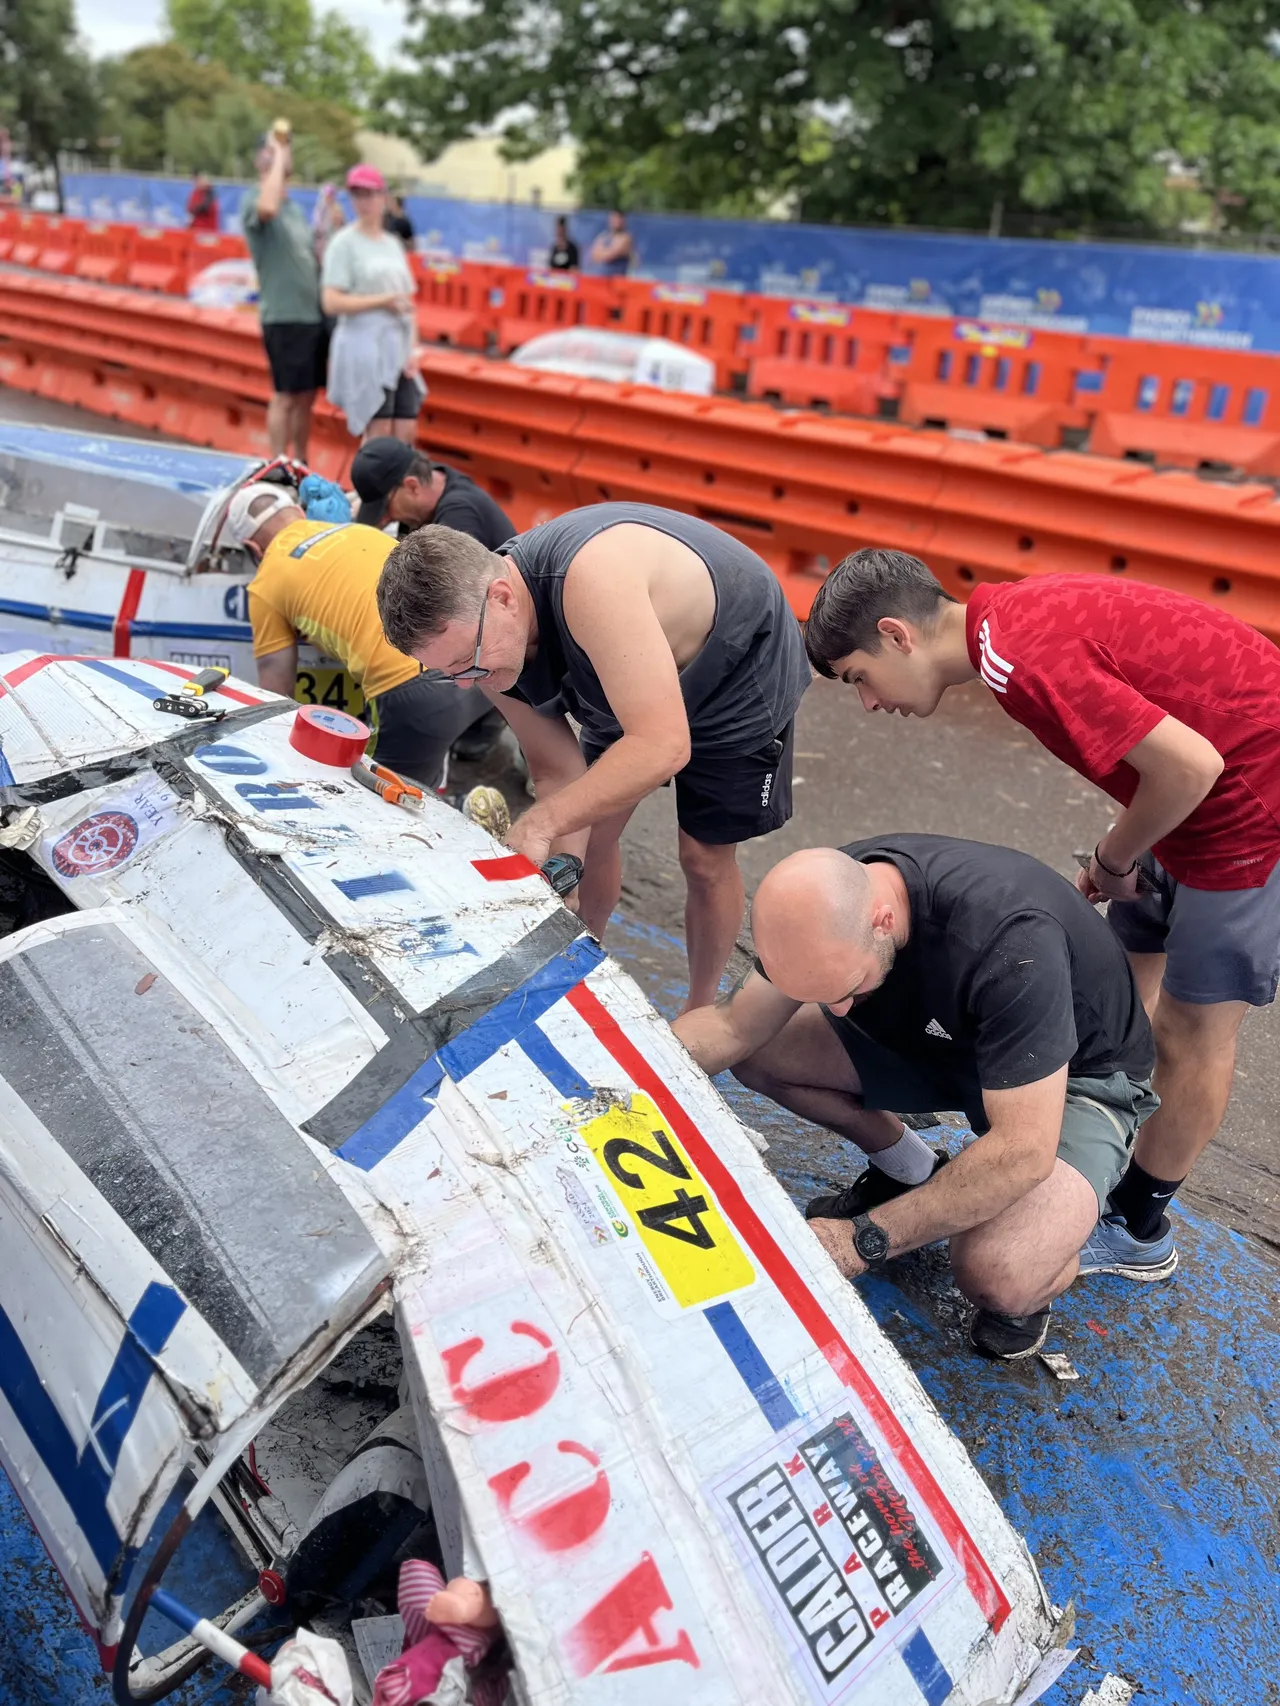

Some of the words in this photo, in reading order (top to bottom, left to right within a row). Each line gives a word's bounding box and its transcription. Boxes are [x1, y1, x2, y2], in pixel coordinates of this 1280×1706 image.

[296, 672, 363, 718] 34
[135, 792, 163, 827] YEAR
[160, 793, 171, 801] 9
[761, 773, 773, 807] adidas
[568, 1193, 590, 1225] PASSED
[582, 1201, 595, 1219] 2024
[602, 1130, 717, 1249] 42
[635, 1253, 666, 1301] BREAKTHROUGH
[645, 1278, 662, 1303] ENERGY
[441, 1319, 700, 1677] ACC
[865, 1484, 904, 1538] home
[783, 1453, 891, 1630] PARK
[804, 1443, 911, 1608] RACEWAY
[737, 1469, 872, 1674] CALDER
